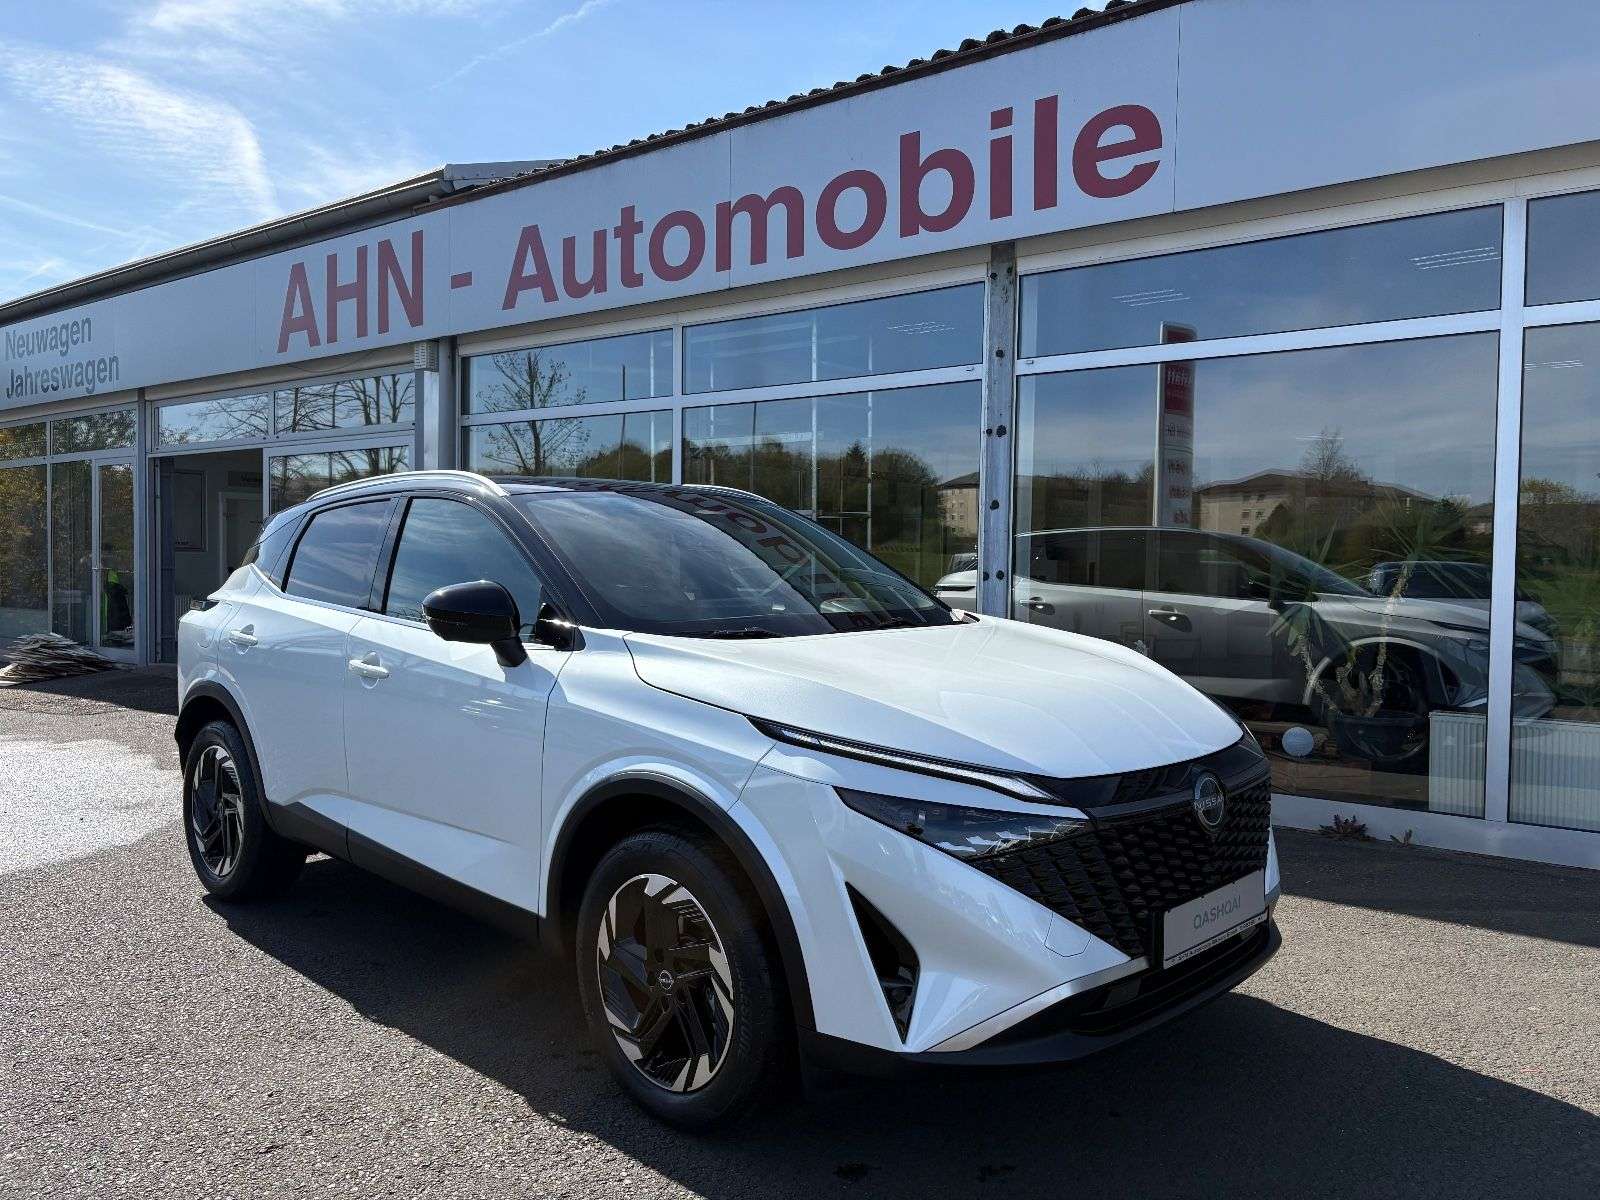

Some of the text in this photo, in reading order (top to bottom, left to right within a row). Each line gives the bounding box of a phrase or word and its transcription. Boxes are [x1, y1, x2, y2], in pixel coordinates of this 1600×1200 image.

[276, 94, 1164, 354] AHN - Automobile
[5, 316, 92, 361] Neuwagen
[6, 355, 120, 399] Jahreswagen
[1193, 895, 1241, 930] QASHQAI
